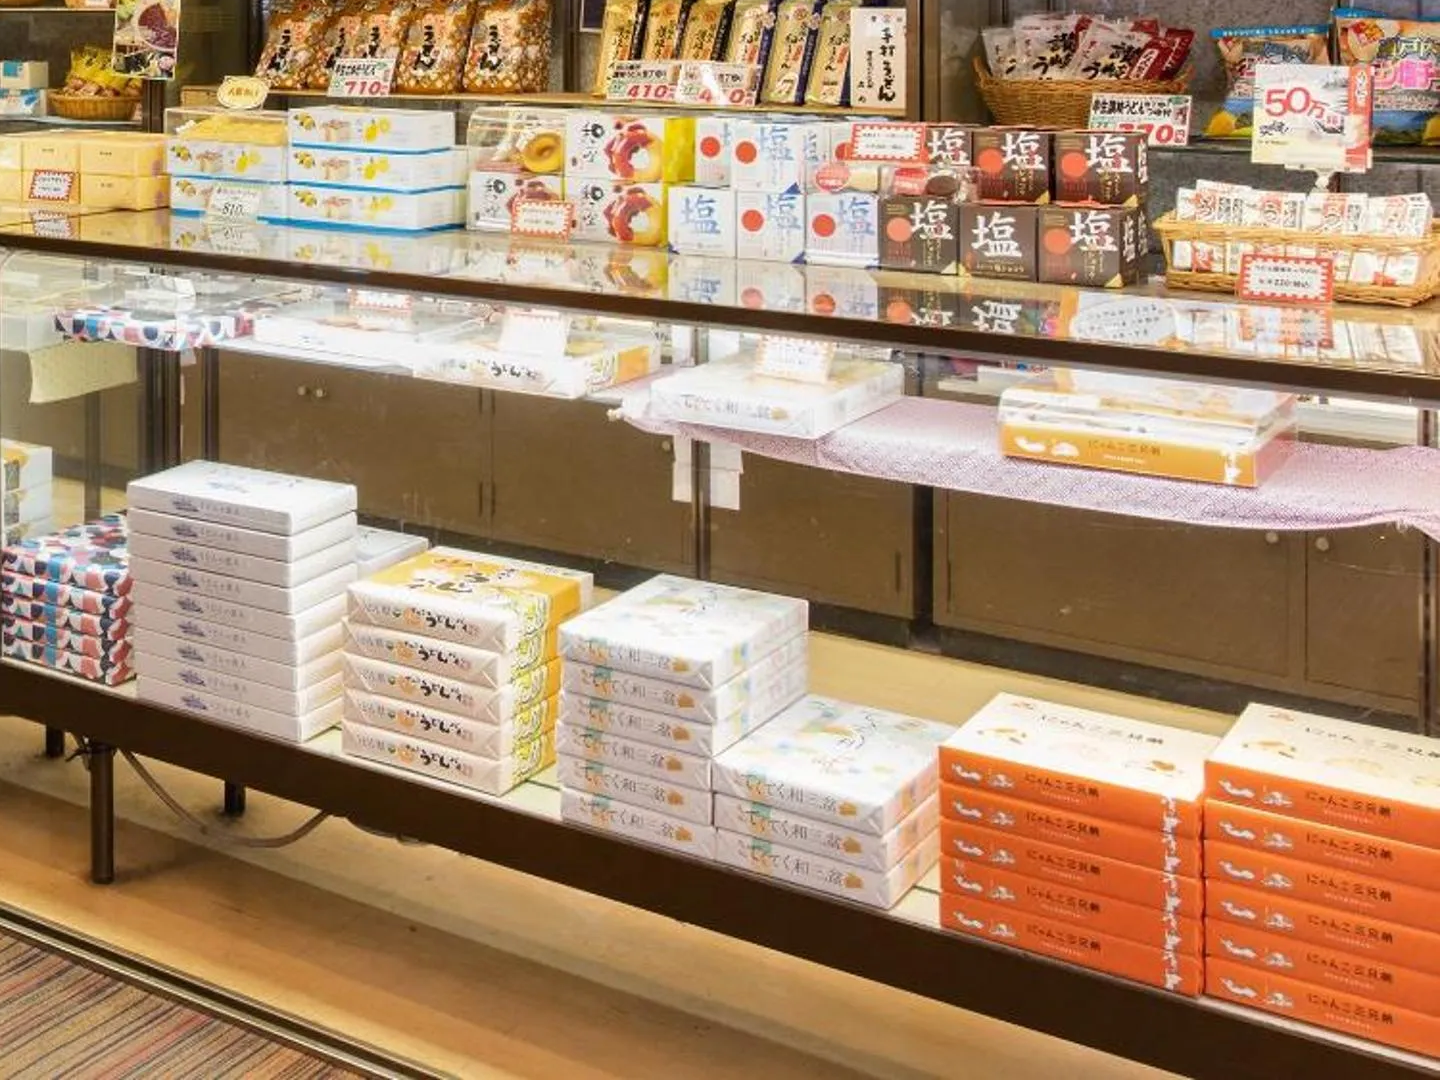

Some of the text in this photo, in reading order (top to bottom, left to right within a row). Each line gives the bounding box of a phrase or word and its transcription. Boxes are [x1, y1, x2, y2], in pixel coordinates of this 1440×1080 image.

[344, 80, 379, 96] 710
[627, 83, 668, 99] 410
[698, 86, 746, 103] 40
[1001, 131, 1047, 170] 塩
[1085, 133, 1135, 173] 塩
[681, 193, 722, 235] 塩
[765, 194, 803, 230] 塩
[837, 196, 876, 235] 塩
[910, 200, 954, 241] 塩
[1070, 210, 1119, 252] 塩
[971, 211, 1023, 258] 塩
